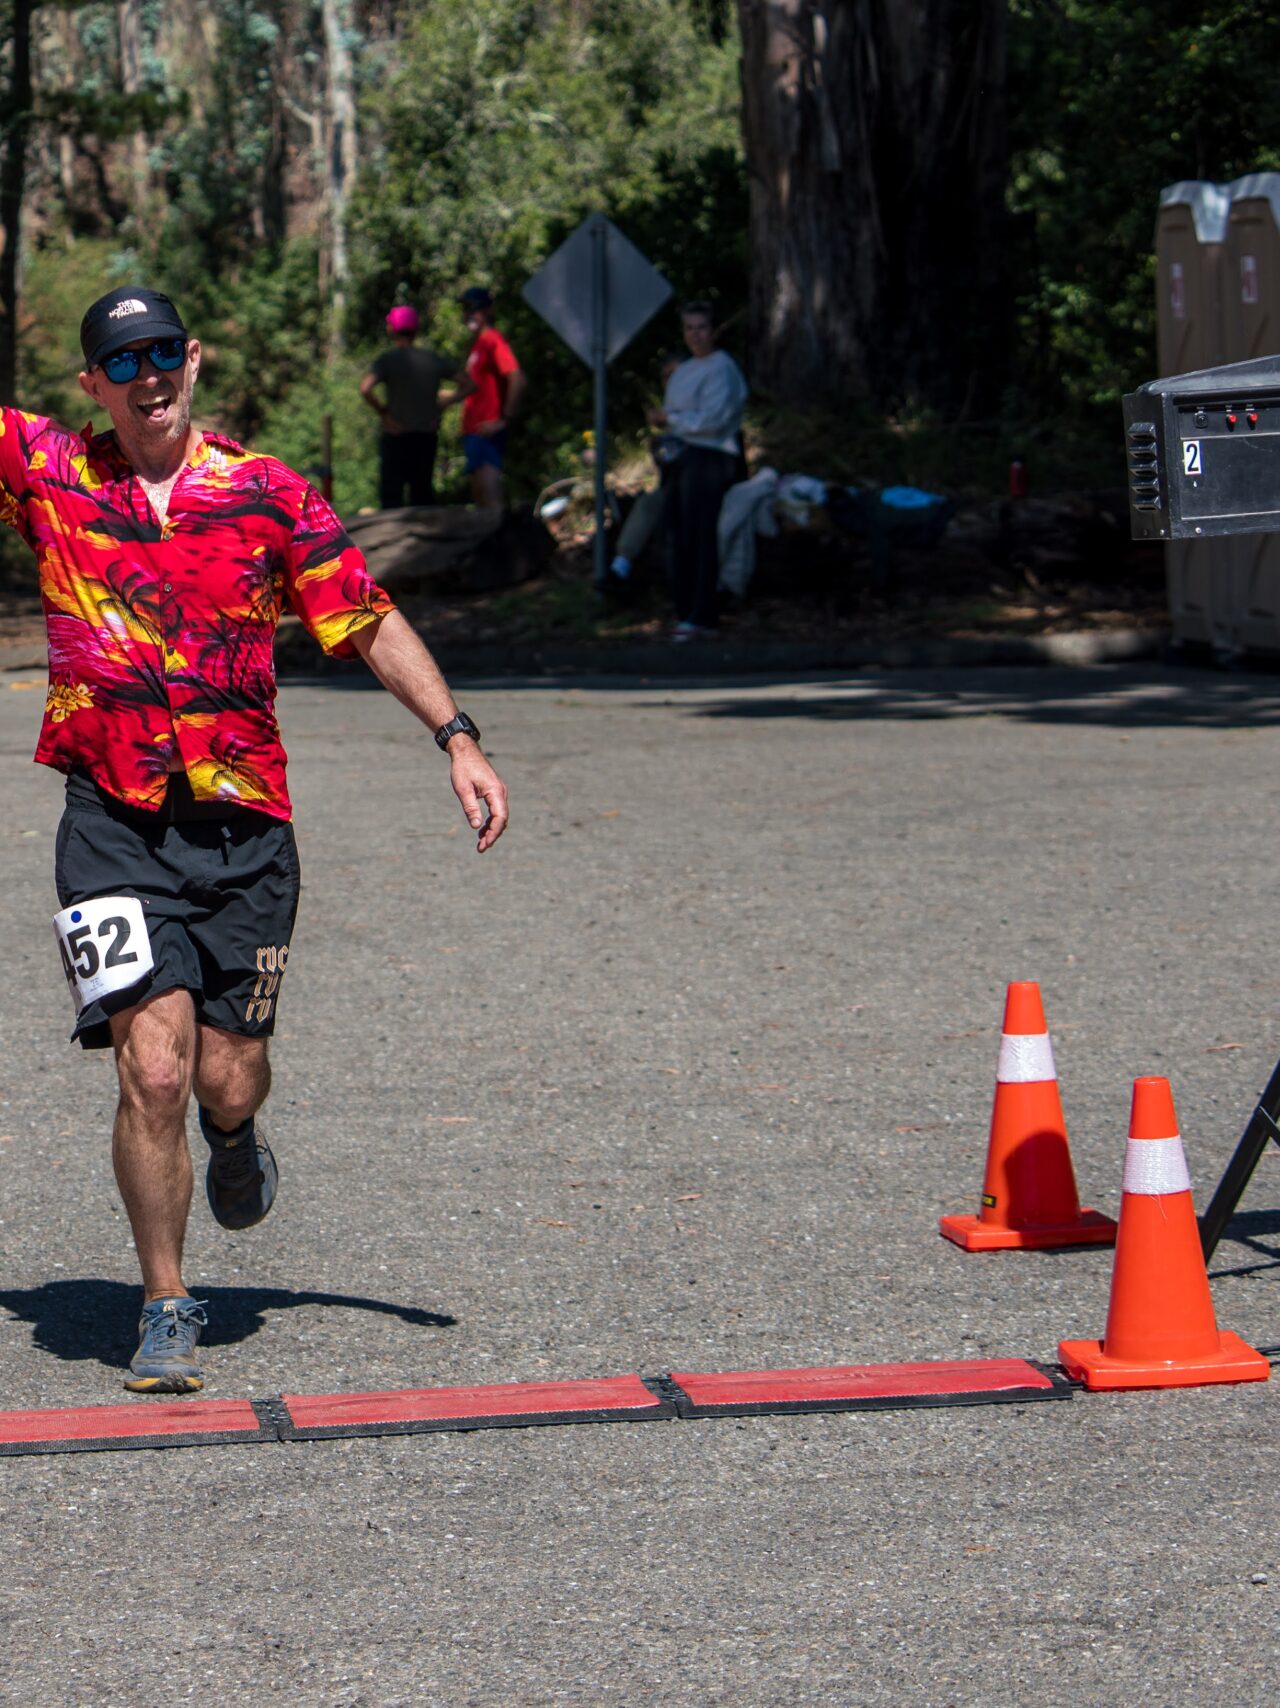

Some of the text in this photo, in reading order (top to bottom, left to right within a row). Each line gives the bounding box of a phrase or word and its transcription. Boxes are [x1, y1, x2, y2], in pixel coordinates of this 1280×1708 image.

[116, 299, 131, 307] THE
[108, 304, 134, 318] NORTH
[116, 308, 135, 319] FACE
[1186, 443, 1199, 472] 2
[59, 915, 138, 987] 452
